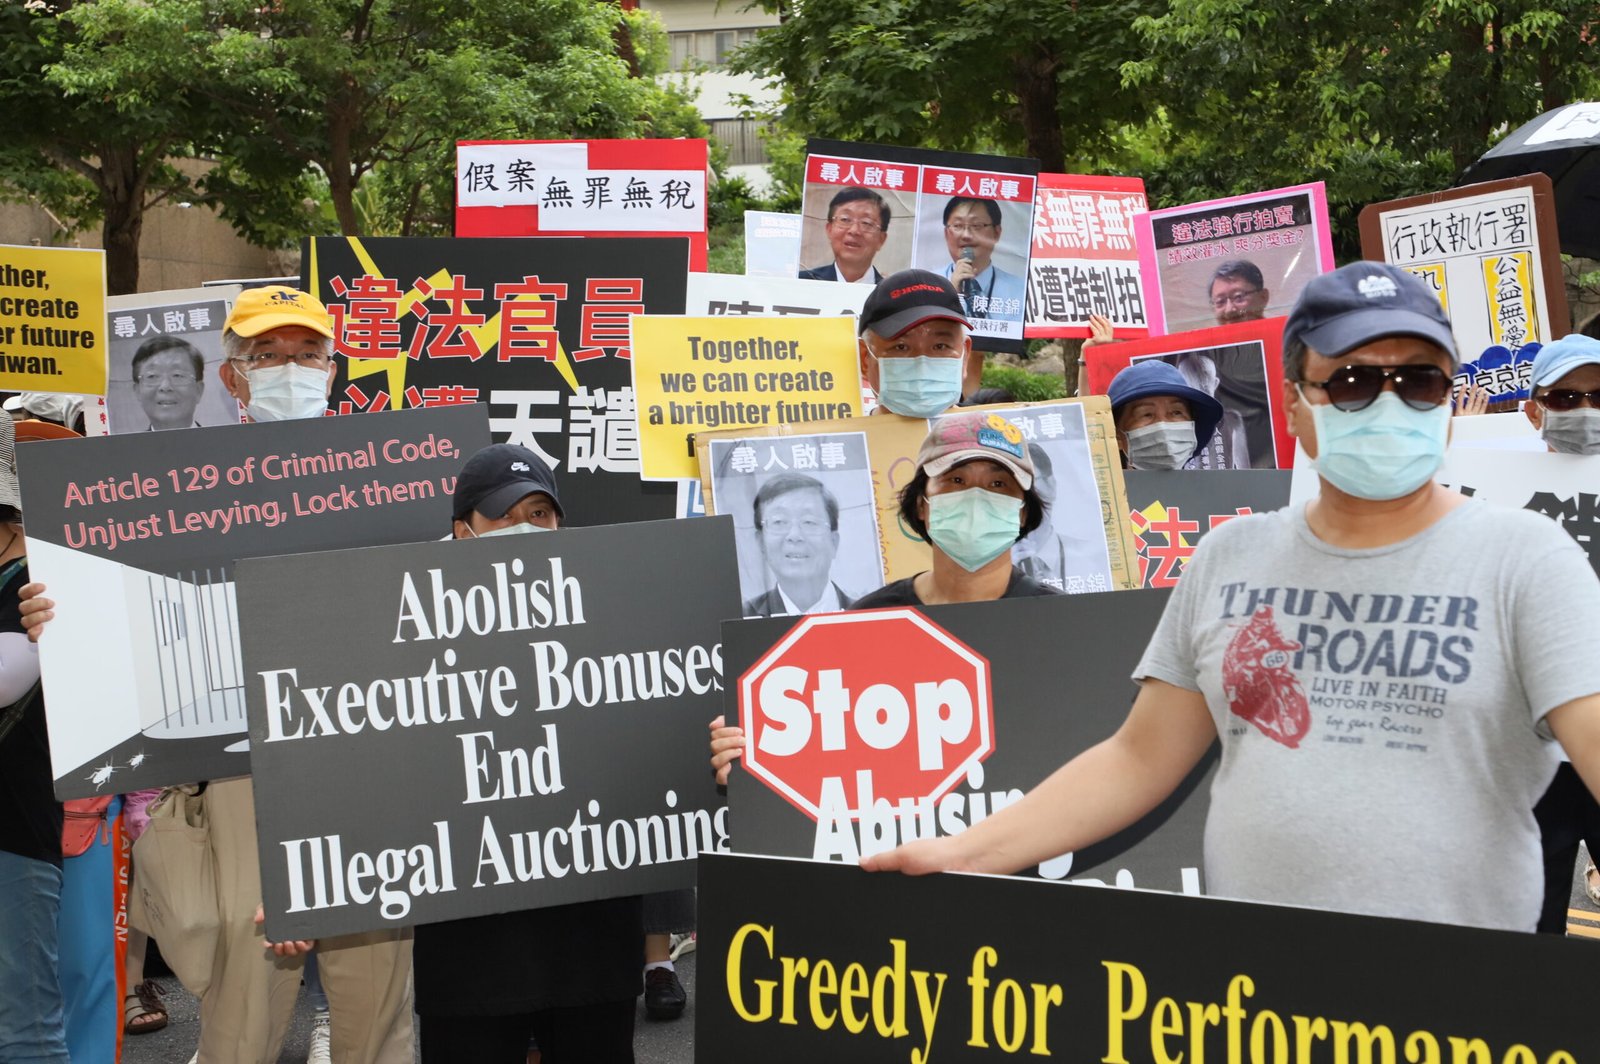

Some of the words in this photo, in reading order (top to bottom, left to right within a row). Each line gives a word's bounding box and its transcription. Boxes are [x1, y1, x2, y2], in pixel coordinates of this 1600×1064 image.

[462, 158, 537, 193] 假案
[541, 175, 696, 210] 無罪無稅
[820, 162, 905, 189] 尋人啟事
[935, 173, 1020, 200] 尋人啟事
[1171, 205, 1296, 245] 違法強行拍賣
[1391, 203, 1528, 260] 行政執行署
[0, 297, 79, 319] create
[326, 274, 645, 363] 違法官員
[973, 295, 1020, 315] 陳盈錦
[21, 324, 94, 348] future
[113, 308, 211, 338] 尋人啟事
[687, 336, 803, 364] Together,
[660, 372, 697, 393] we
[703, 371, 749, 393] can
[755, 369, 834, 392] create
[648, 406, 664, 425] a
[670, 401, 770, 428] brighter
[776, 402, 852, 425] future
[64, 472, 160, 508] Article
[168, 466, 220, 494] 129
[226, 457, 256, 485] of
[261, 442, 378, 482] Criminal
[383, 434, 460, 464] Code,
[731, 442, 847, 473] 尋人啟事
[64, 515, 163, 550] Unjust
[170, 499, 288, 534] Levying,
[293, 477, 359, 517] Lock
[362, 479, 436, 509] them
[392, 557, 586, 643] Abolish
[1219, 582, 1480, 631] THUNDER
[1293, 622, 1475, 685] ROADS
[257, 648, 518, 744] Executive
[1309, 695, 1367, 711] MOTOR
[1371, 699, 1444, 720] PSYCHO
[1312, 677, 1352, 696] LIVE
[1358, 681, 1380, 699] IN
[1387, 683, 1448, 706] FAITH
[758, 666, 974, 772] Stop
[456, 723, 564, 805] End
[279, 821, 457, 920] Illegal
[726, 923, 948, 1064] Greedy
[967, 946, 1063, 1056] for
